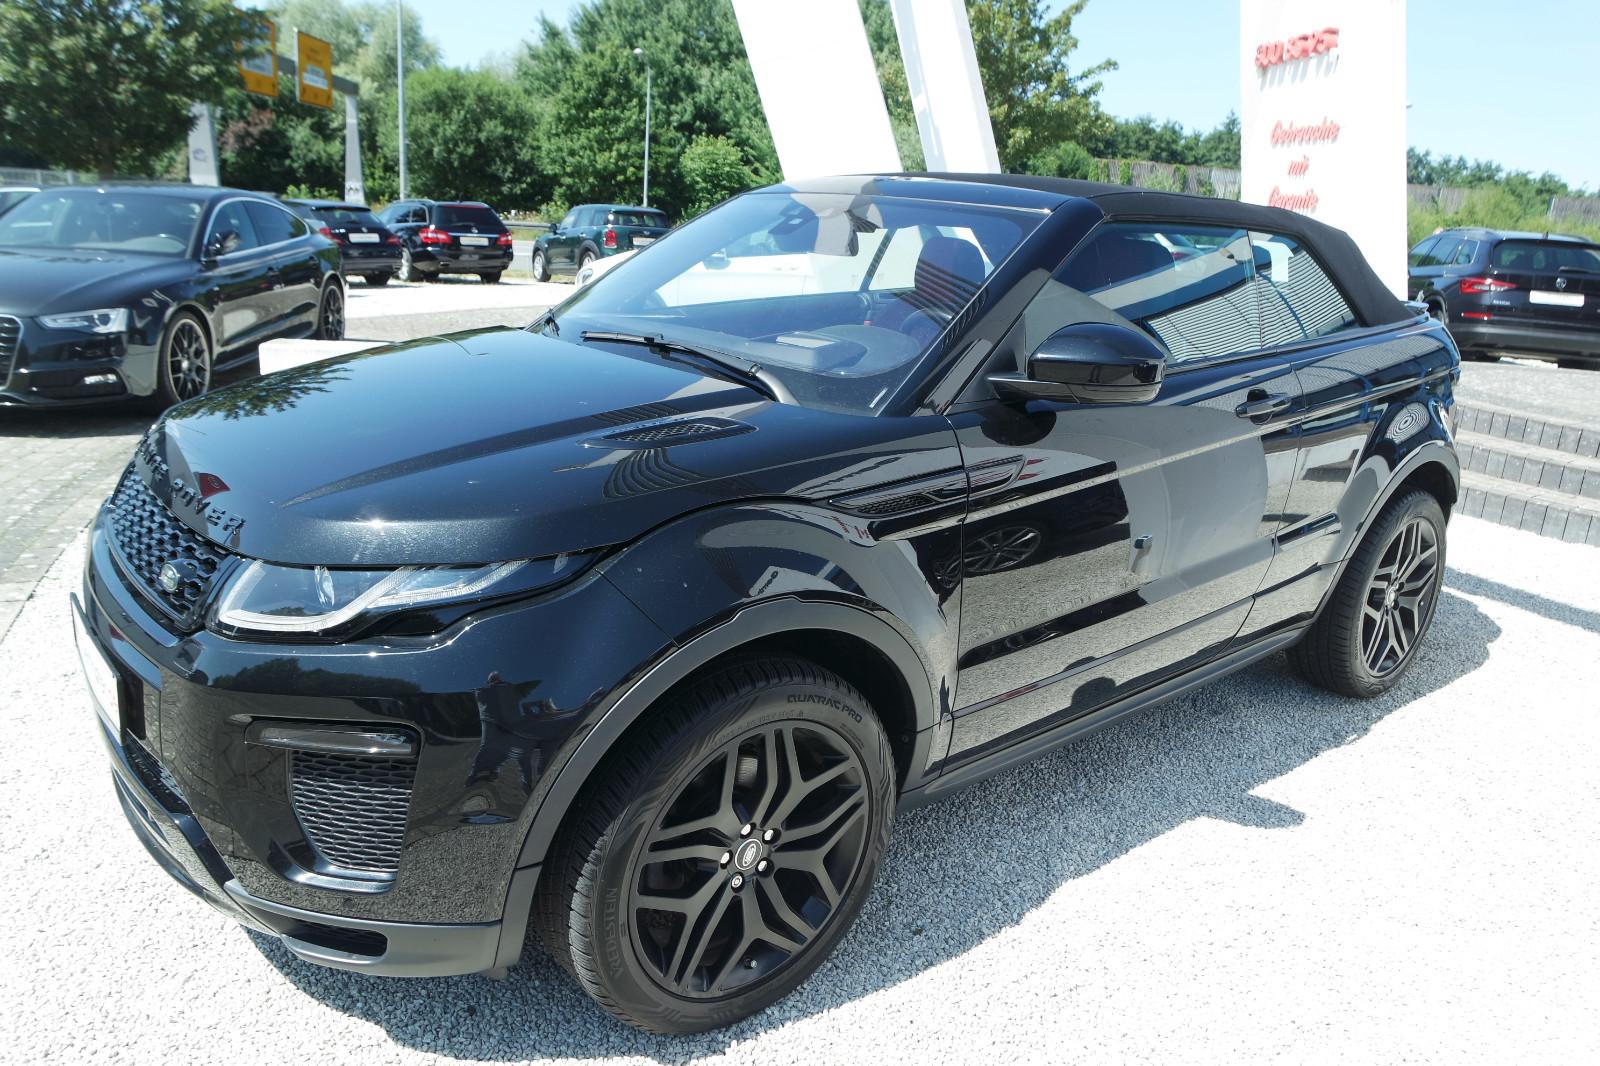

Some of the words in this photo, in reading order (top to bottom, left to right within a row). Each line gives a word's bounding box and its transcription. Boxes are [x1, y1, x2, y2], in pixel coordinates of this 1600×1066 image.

[787, 694, 841, 710] QUATRAC
[841, 704, 863, 724] PRO
[604, 887, 624, 979] VREDESTEIN
